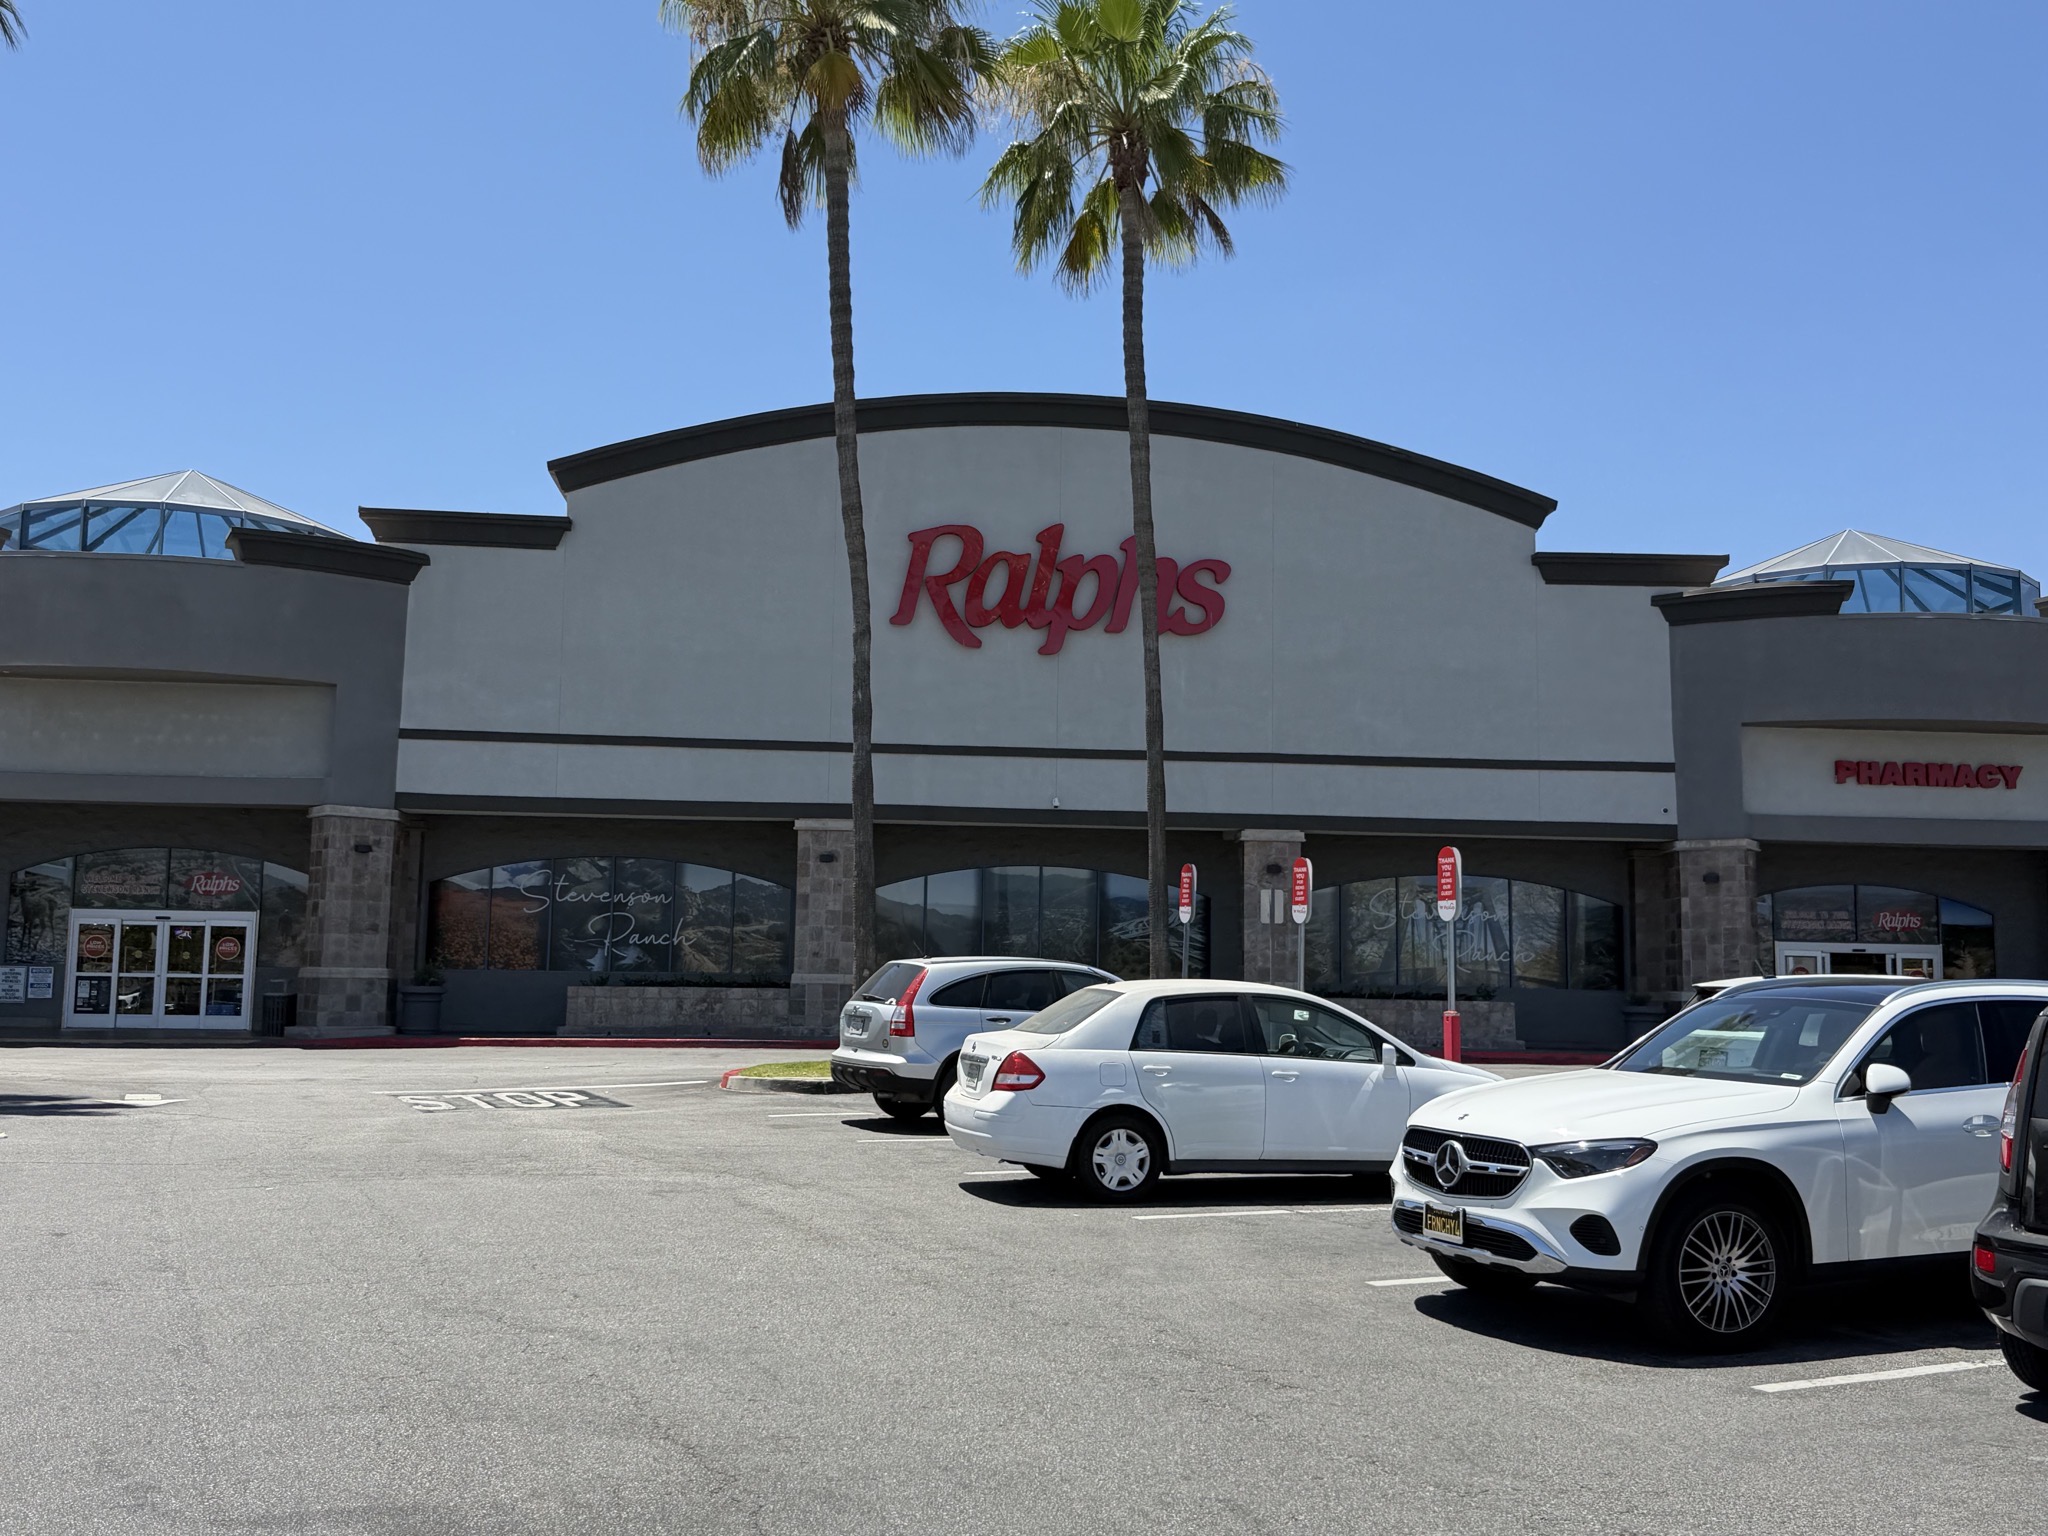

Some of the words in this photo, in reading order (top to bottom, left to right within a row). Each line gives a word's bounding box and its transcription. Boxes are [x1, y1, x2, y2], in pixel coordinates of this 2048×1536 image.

[889, 523, 1232, 655] Ralphs
[1834, 760, 2023, 789] PHARMACY
[190, 874, 240, 895] Ralphs
[520, 870, 672, 913] Stevenson
[588, 912, 697, 956] Ranch
[1878, 912, 1921, 931] Ralphs
[397, 1091, 590, 1110] STOP
[1427, 1214, 1460, 1236] FRNCHY4
